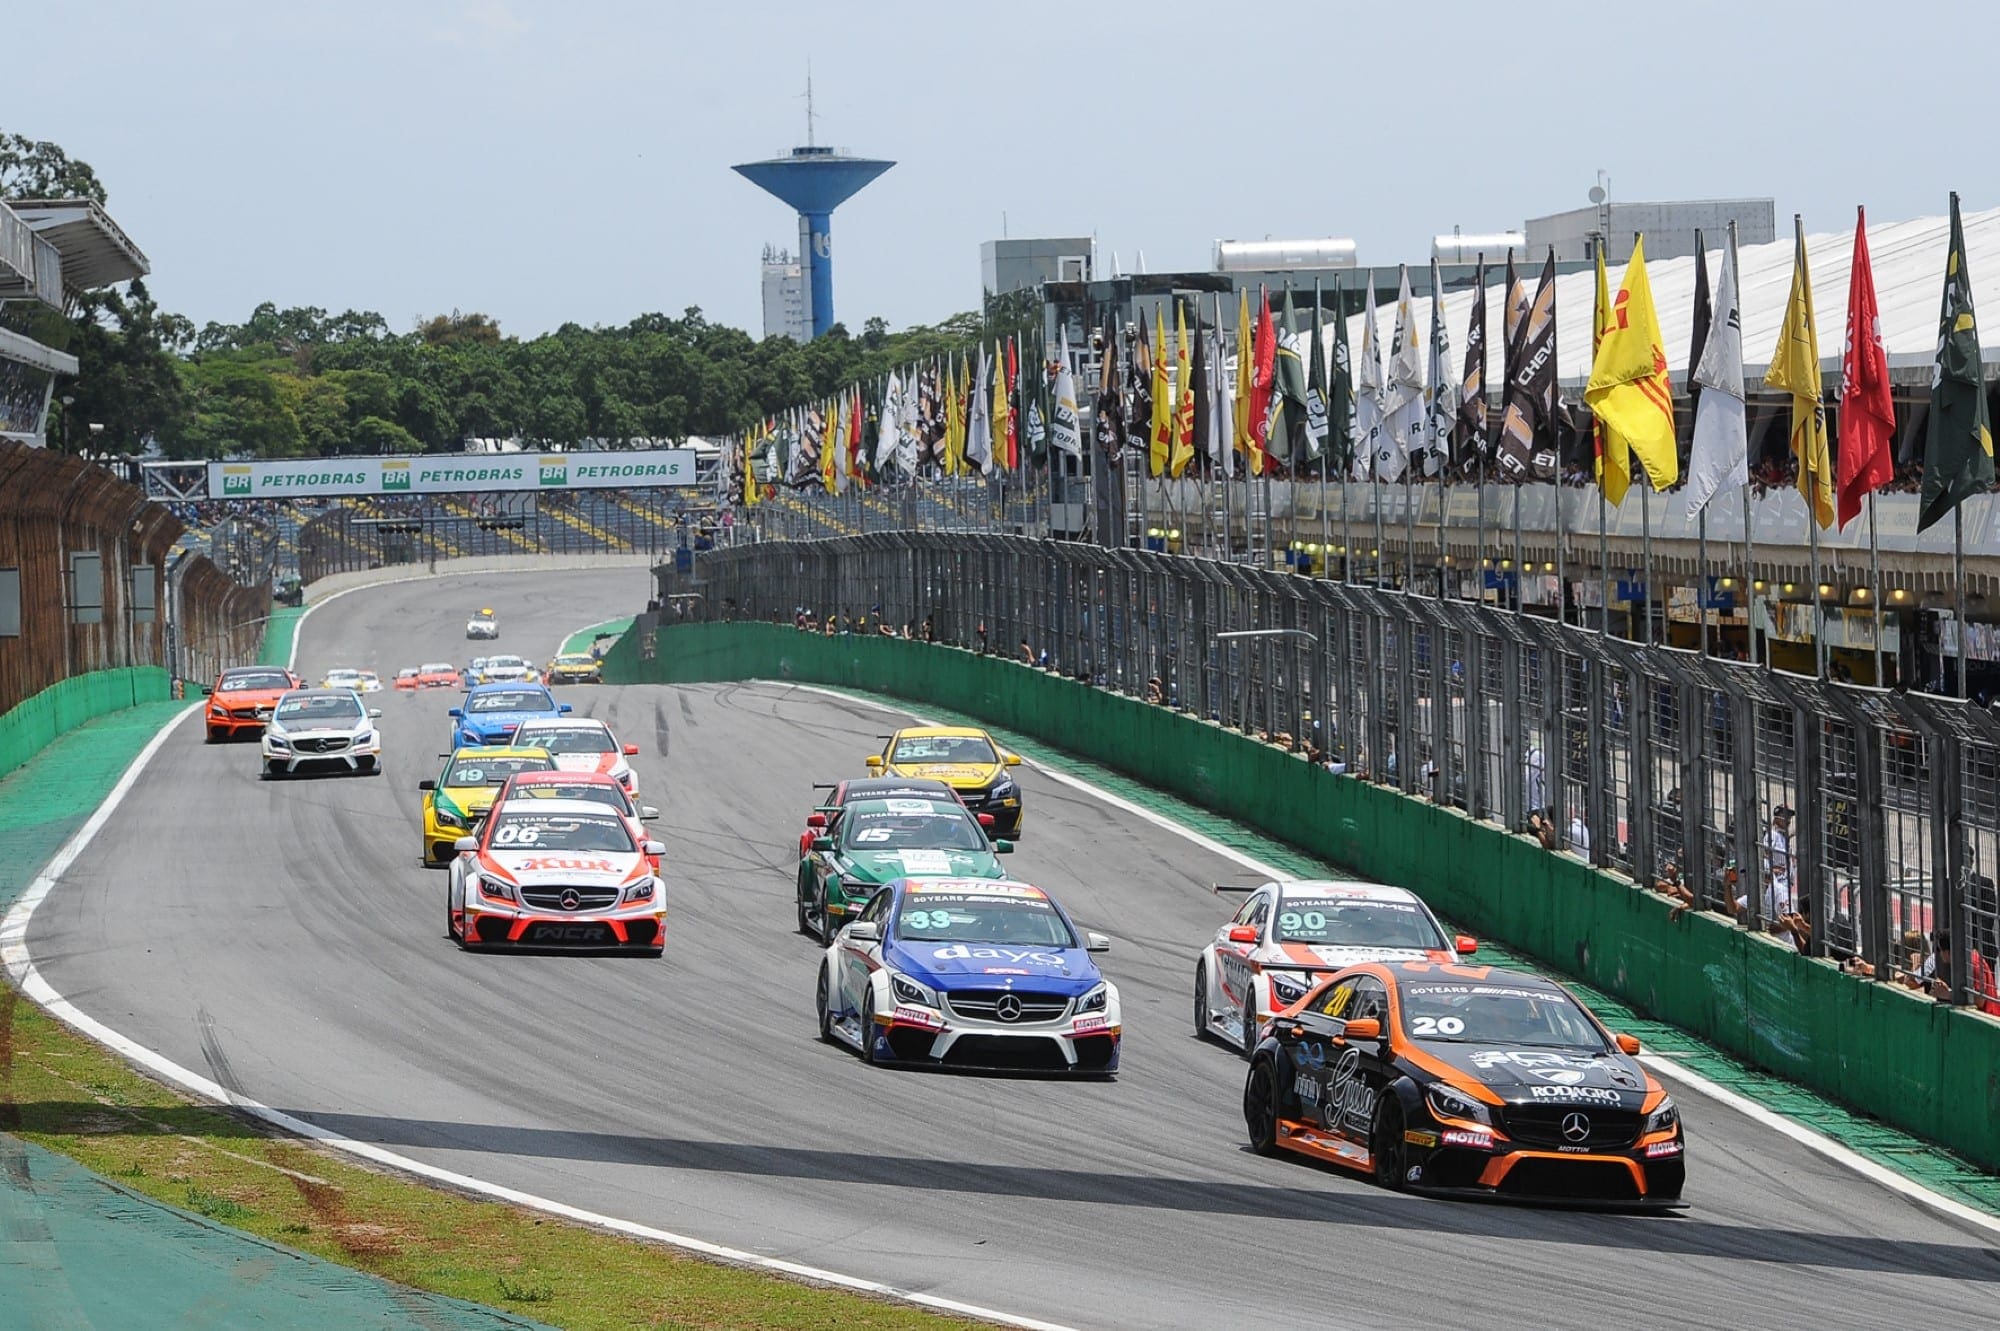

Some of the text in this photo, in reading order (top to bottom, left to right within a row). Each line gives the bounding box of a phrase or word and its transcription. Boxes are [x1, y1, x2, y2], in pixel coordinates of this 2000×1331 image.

[384, 468, 523, 484] BR PETROBRAS
[541, 464, 679, 479] BR PETROBRAS
[227, 473, 366, 488] BR PETROBRAS
[222, 682, 247, 690] 62
[896, 746, 927, 758] 55
[456, 769, 484, 781] 19
[495, 826, 540, 843] 06
[856, 828, 894, 842] 15
[910, 910, 951, 929] 33
[1279, 911, 1326, 931] 90
[932, 944, 1065, 965] dayo
[1323, 985, 1352, 1017] 20
[1412, 1016, 1466, 1035] 20
[1530, 1085, 1622, 1102] RODAGRO
[1444, 1132, 1492, 1146] MOTUL
